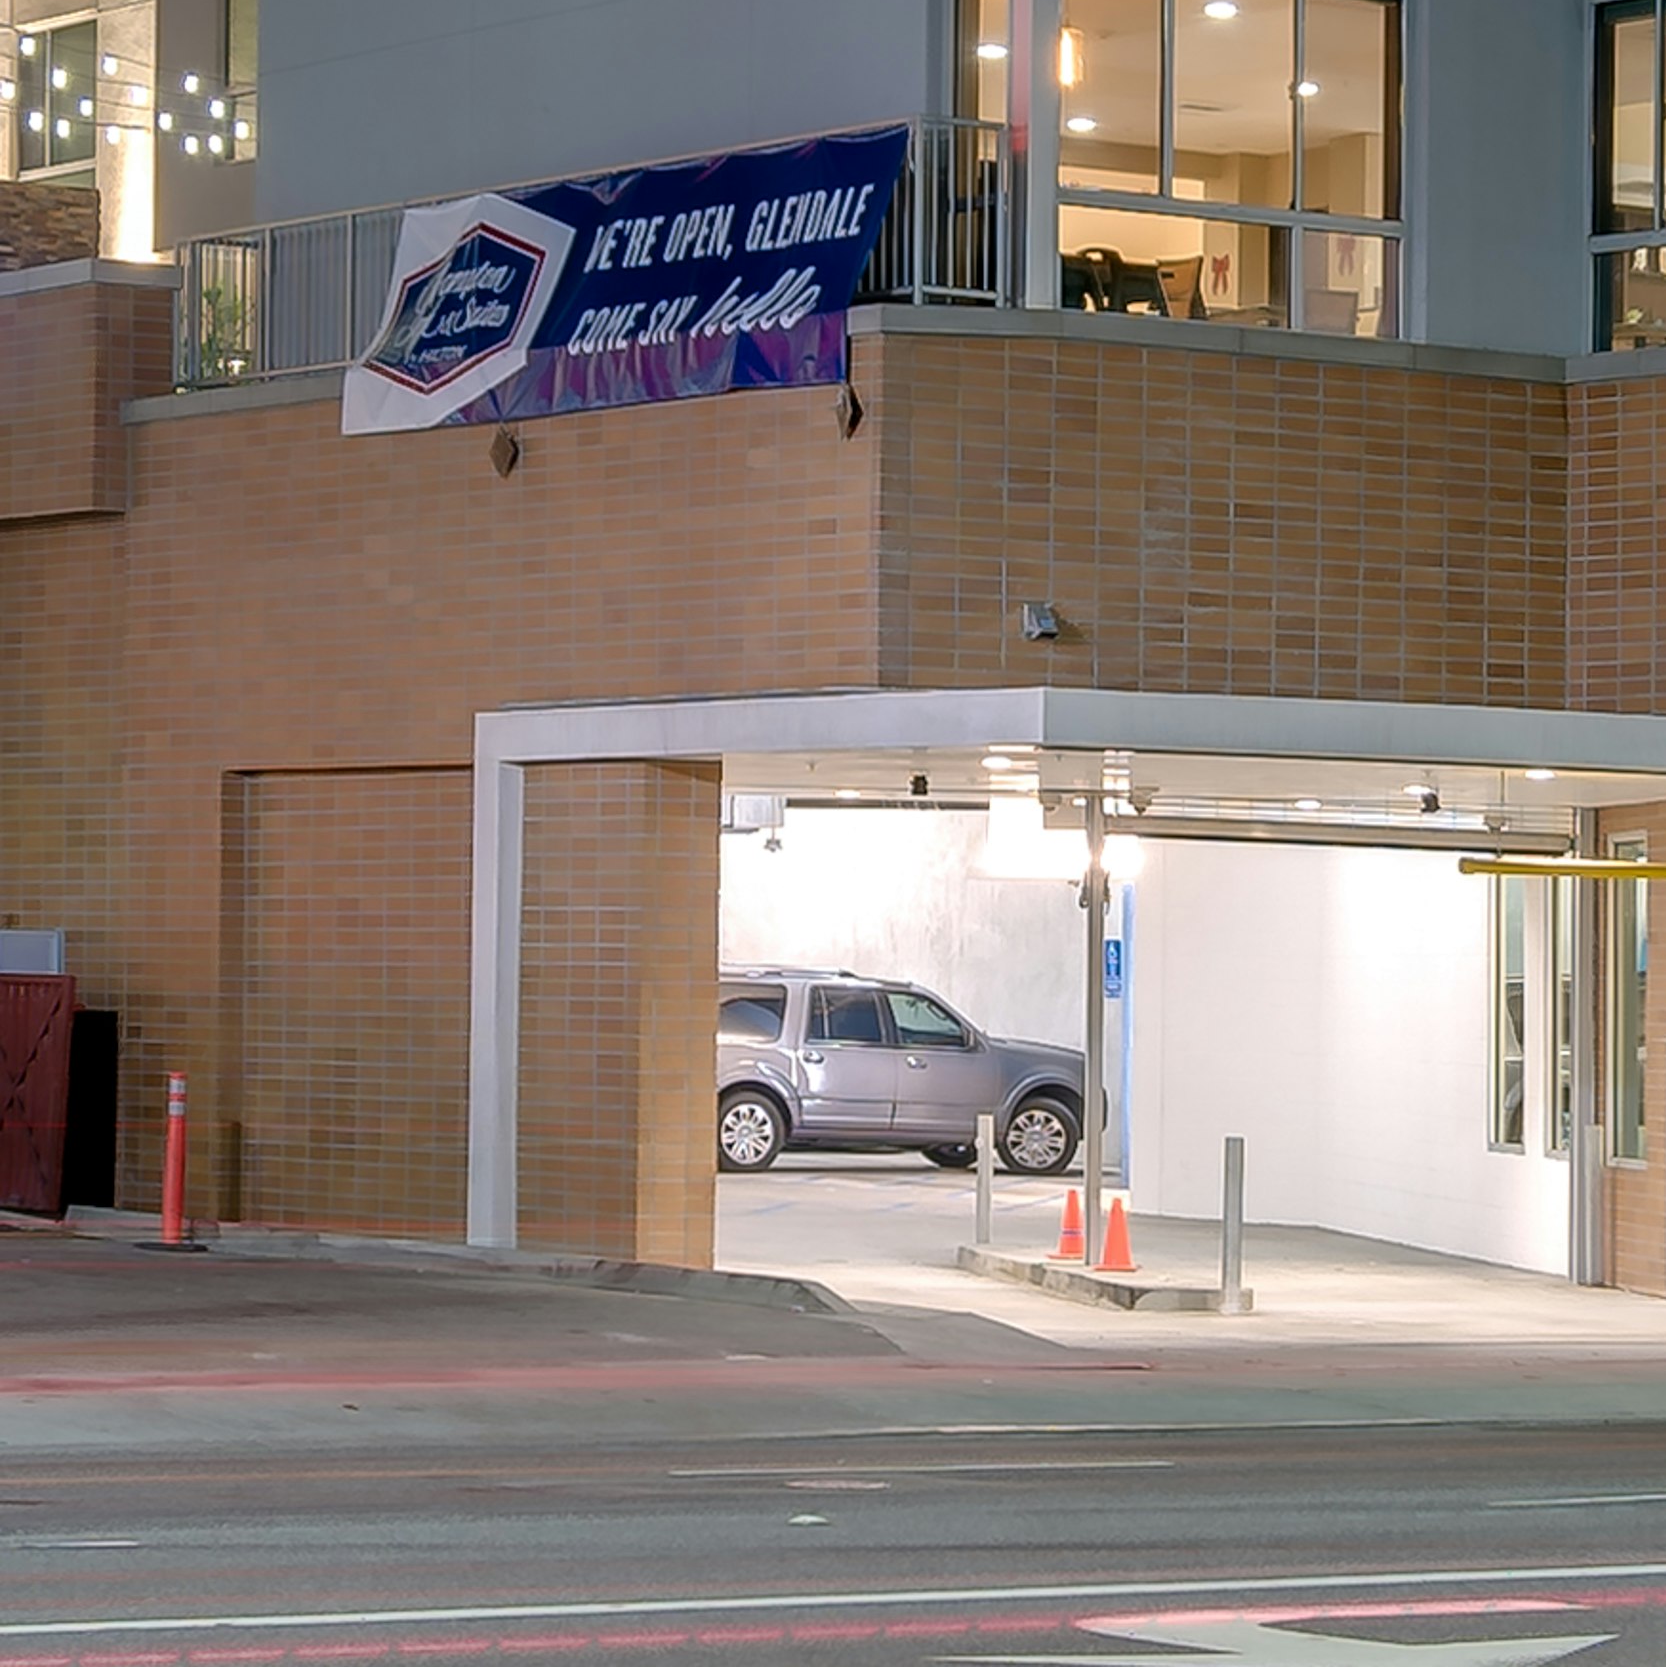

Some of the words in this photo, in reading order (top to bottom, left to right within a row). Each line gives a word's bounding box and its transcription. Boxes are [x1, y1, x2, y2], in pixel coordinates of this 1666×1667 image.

[663, 203, 736, 261] OPEN,
[744, 183, 876, 252] GLENDALE
[568, 302, 646, 355] COME
[638, 295, 699, 346] SAY
[690, 266, 822, 339] hello
